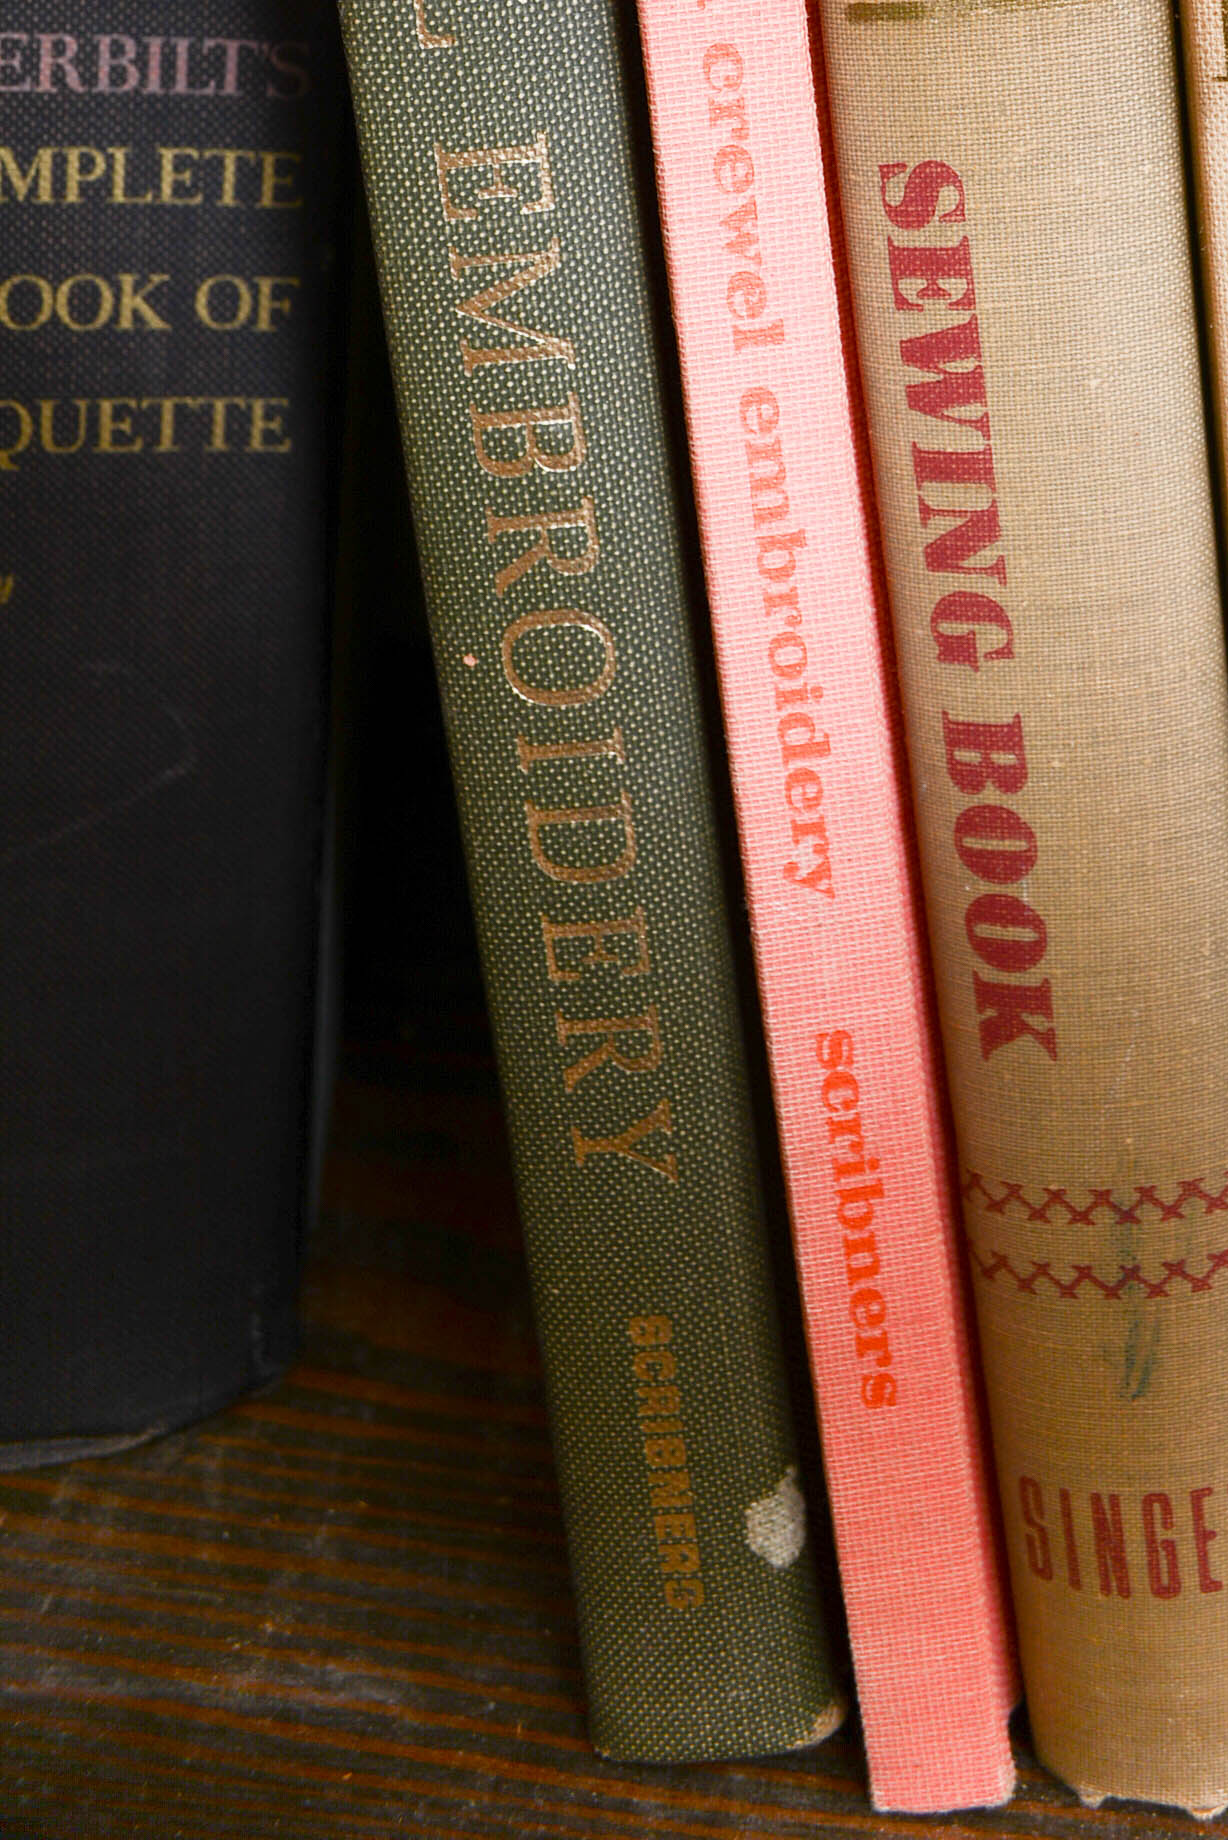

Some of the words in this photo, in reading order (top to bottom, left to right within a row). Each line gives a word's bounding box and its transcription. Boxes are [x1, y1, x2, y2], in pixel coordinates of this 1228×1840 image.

[195, 275, 300, 333] OF
[701, 41, 787, 352] crewel
[879, 159, 1015, 672] SEWING
[738, 385, 836, 901] embroidery
[433, 130, 679, 1184] EMBROIDERY
[628, 1314, 705, 1610] SCRIBNERS
[941, 710, 1059, 1062] BOOK
[815, 1029, 898, 1410] scribners
